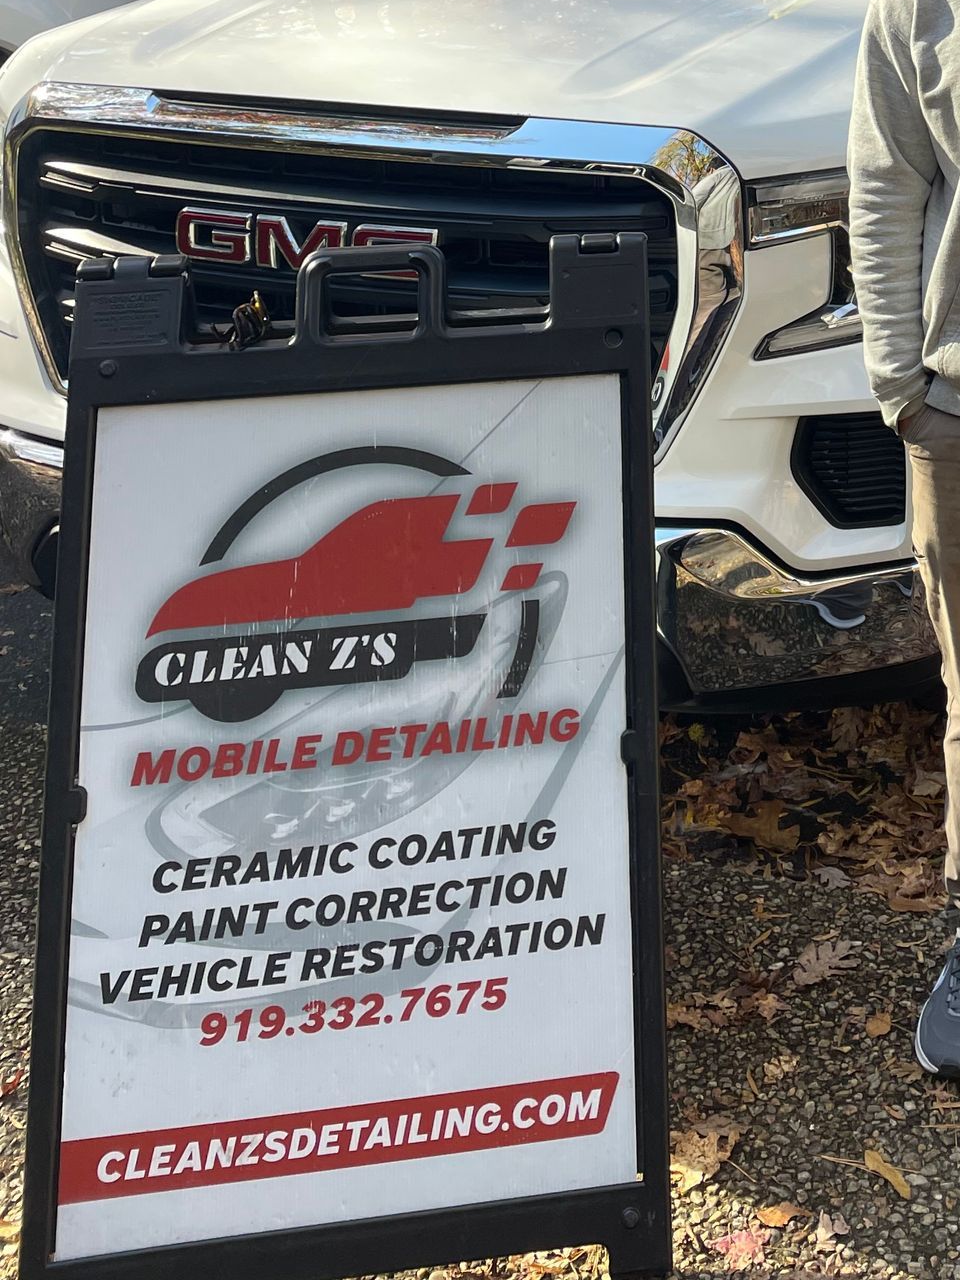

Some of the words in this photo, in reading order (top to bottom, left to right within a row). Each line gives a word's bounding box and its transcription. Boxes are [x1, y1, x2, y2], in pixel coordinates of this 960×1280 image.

[154, 641, 311, 687] CLEAN
[328, 631, 398, 670] Z'S
[130, 734, 323, 786] MOBILE
[330, 708, 581, 768] DETAILING
[152, 841, 357, 894] CERAMIC
[367, 819, 557, 869] COATING
[138, 900, 279, 947] PAINT
[284, 867, 568, 931] CORRECTION
[99, 951, 288, 1004] VEHICLE
[299, 914, 606, 982] RESTORATION
[199, 977, 508, 1047] 919.332.7675
[96, 1088, 601, 1183] CLEANZSDETAILING.COM
